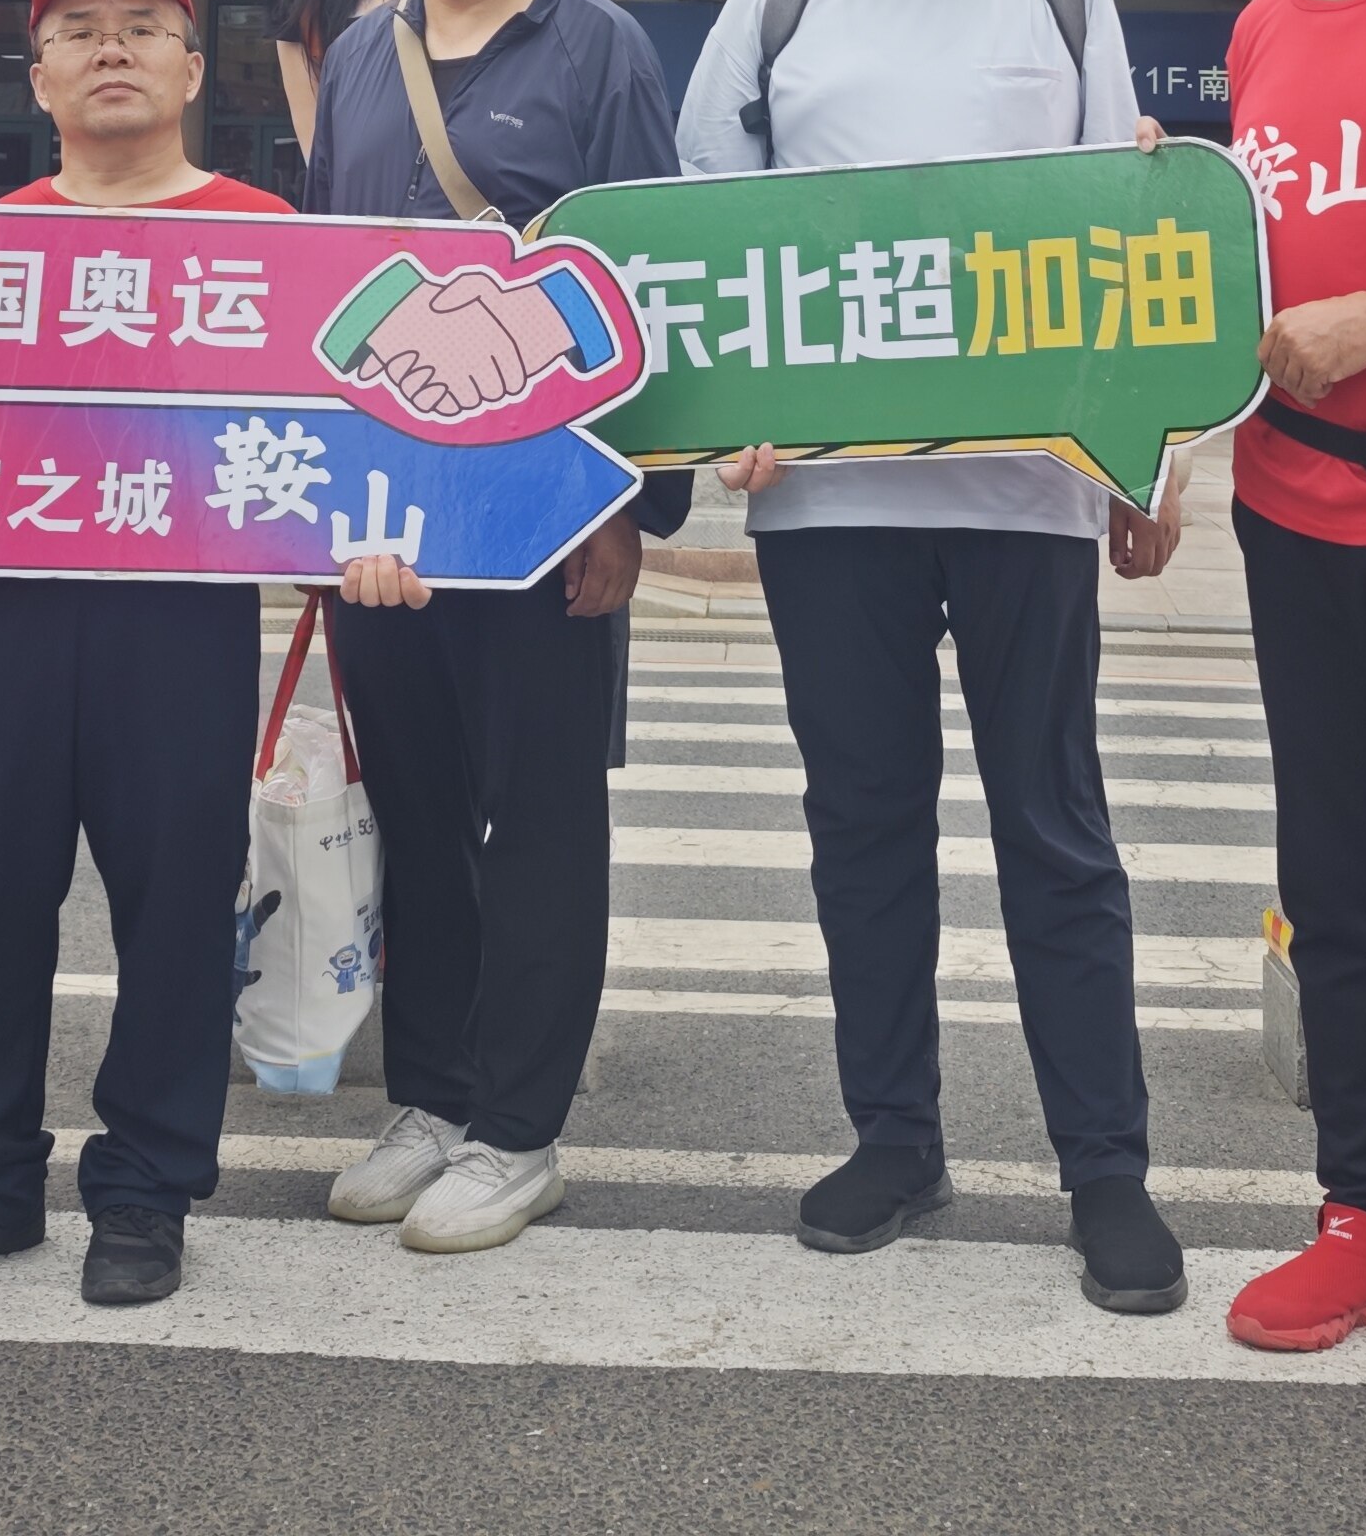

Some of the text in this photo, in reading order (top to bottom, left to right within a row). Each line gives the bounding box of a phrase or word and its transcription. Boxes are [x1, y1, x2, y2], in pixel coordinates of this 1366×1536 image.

[620, 217, 1217, 373] 东北超加油
[204, 417, 425, 565] 鞍山
